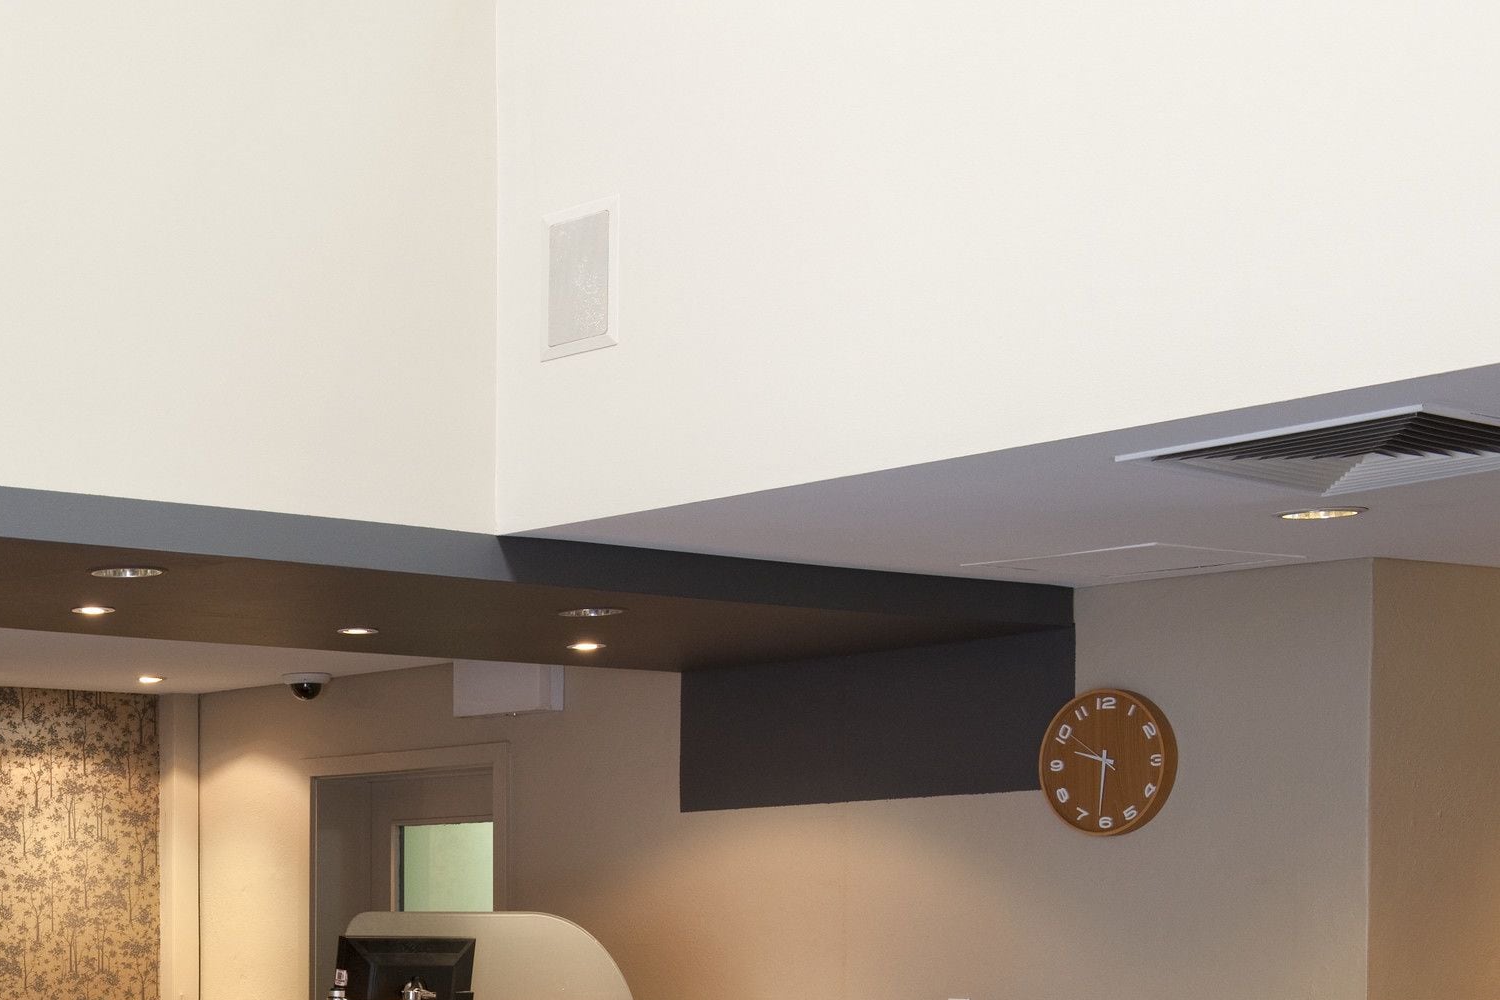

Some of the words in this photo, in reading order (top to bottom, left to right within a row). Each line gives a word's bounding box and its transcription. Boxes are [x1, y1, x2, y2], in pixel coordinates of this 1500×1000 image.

[1096, 697, 1116, 710] 12
[1127, 704, 1136, 716] 1
[1075, 706, 1088, 721] 11
[1055, 724, 1071, 745] 10
[1142, 722, 1156, 739] 2
[1050, 760, 1064, 772] 9
[1150, 754, 1162, 767] 3
[1056, 787, 1069, 803] 8
[1144, 783, 1156, 798] 4
[1076, 806, 1090, 820] 7
[1123, 805, 1137, 820] 5
[1099, 816, 1112, 829] 6
